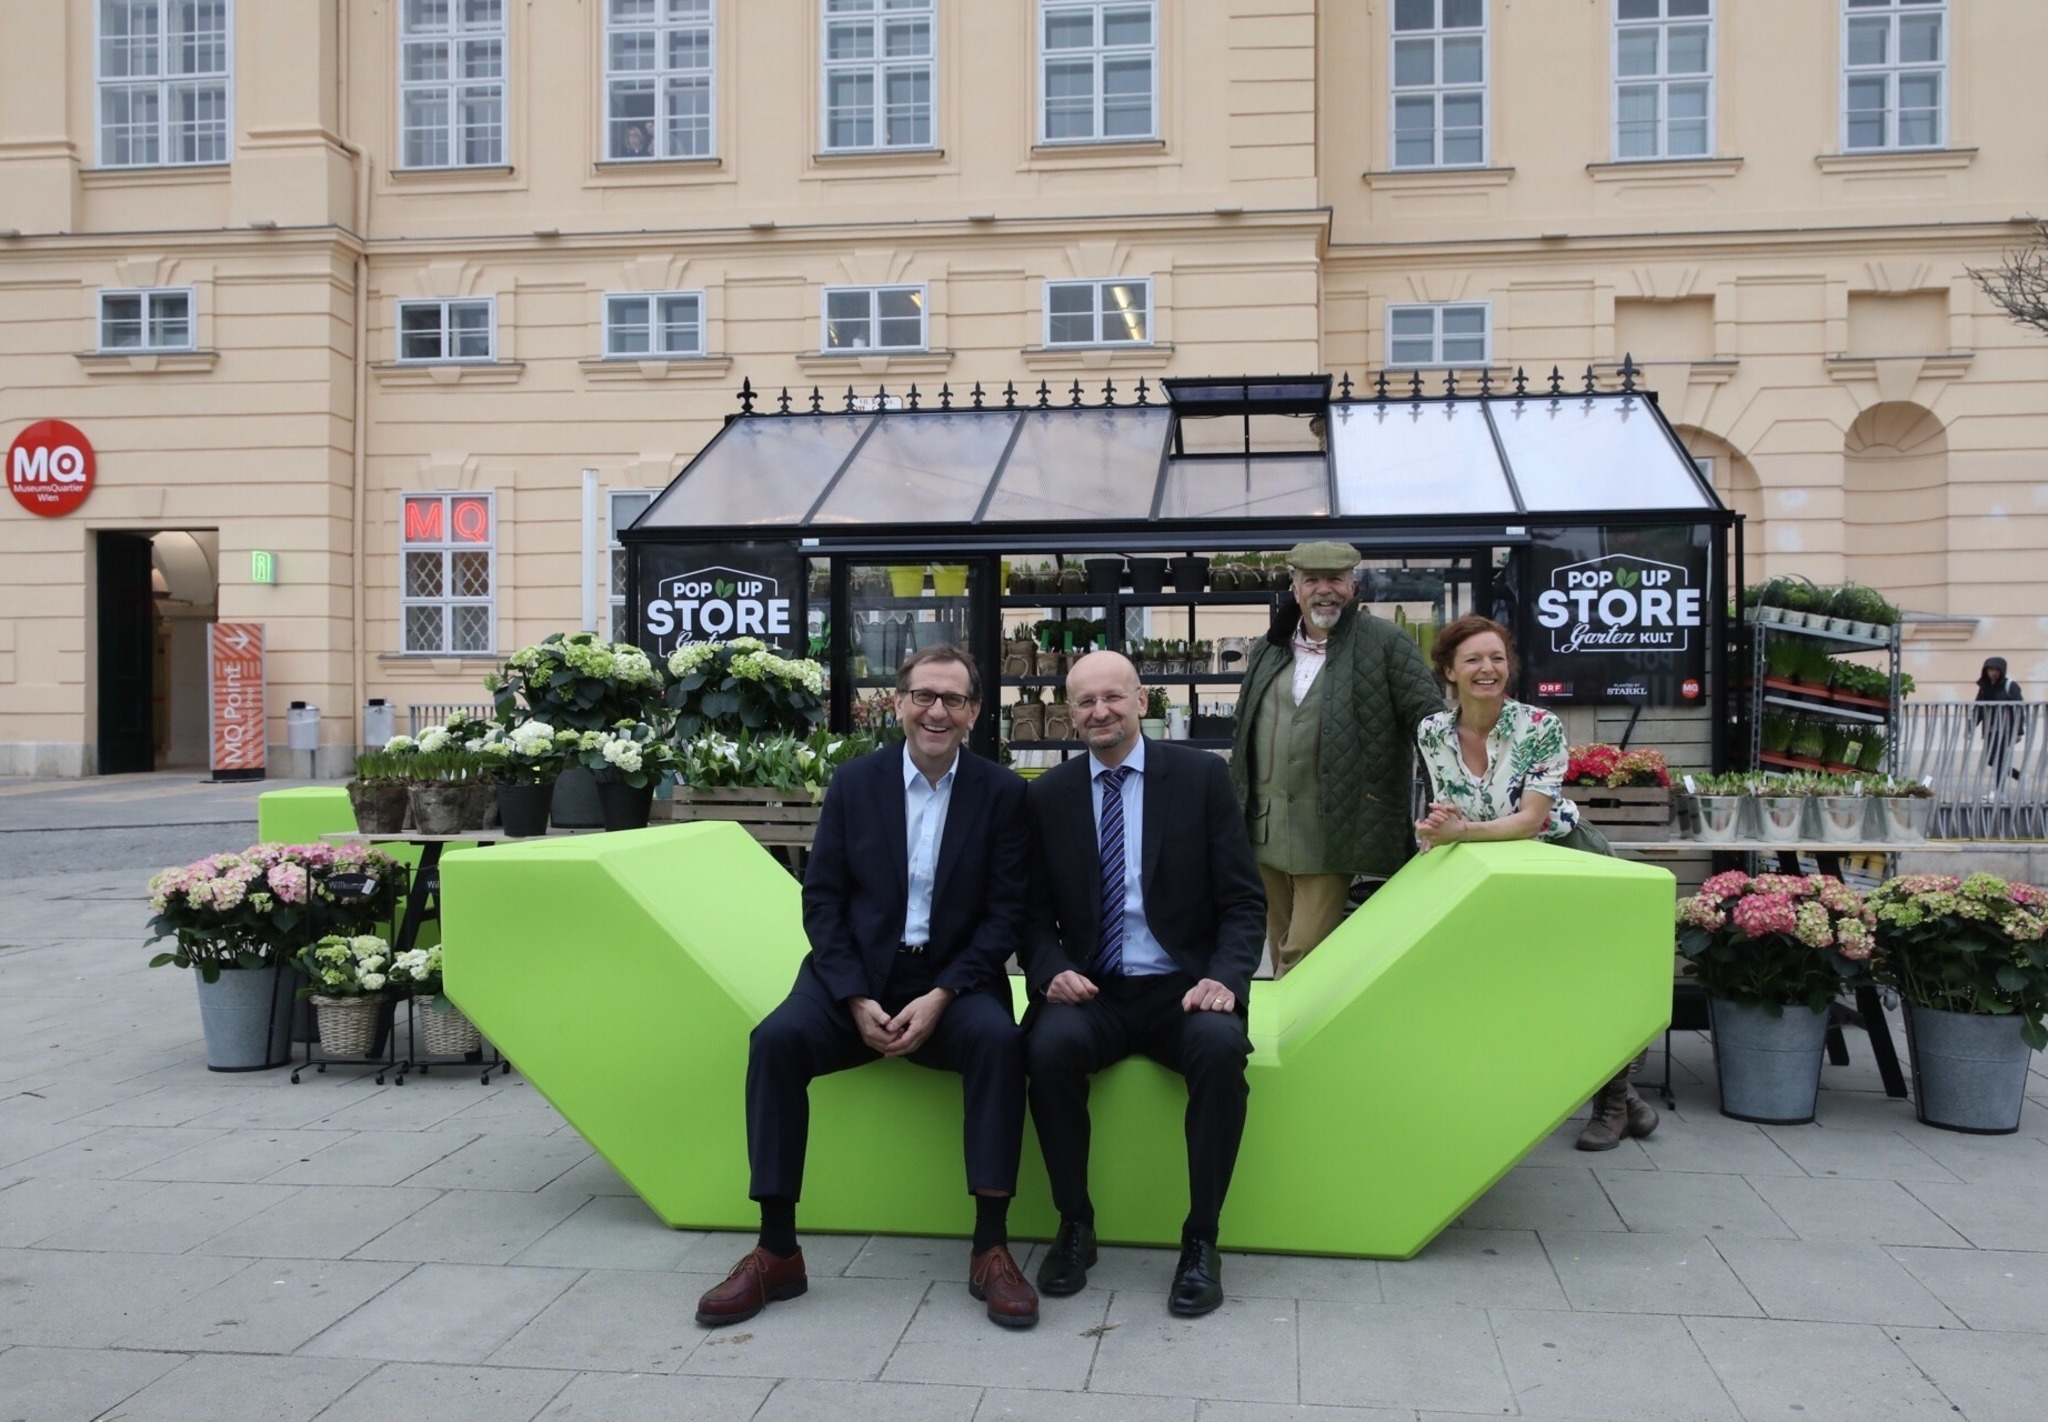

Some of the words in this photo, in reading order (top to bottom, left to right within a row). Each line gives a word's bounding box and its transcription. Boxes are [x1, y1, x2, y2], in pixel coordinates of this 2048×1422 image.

[14, 445, 87, 482] MQ
[13, 484, 84, 494] MuseumsQuartier
[37, 494, 59, 502] Wien
[406, 502, 486, 543] MQ
[673, 582, 713, 598] POP
[737, 581, 763, 597] UP
[1568, 571, 1614, 588] POP
[1641, 570, 1671, 586] UP
[647, 599, 791, 635] STORE
[1537, 588, 1701, 628] STORE
[1560, 622, 1637, 653] Garten
[1640, 632, 1674, 644] KULT
[223, 664, 242, 719] Point
[246, 687, 254, 708] Shop
[1540, 684, 1561, 692] ORF
[1682, 683, 1699, 692] MQ
[224, 725, 244, 763] MQ
